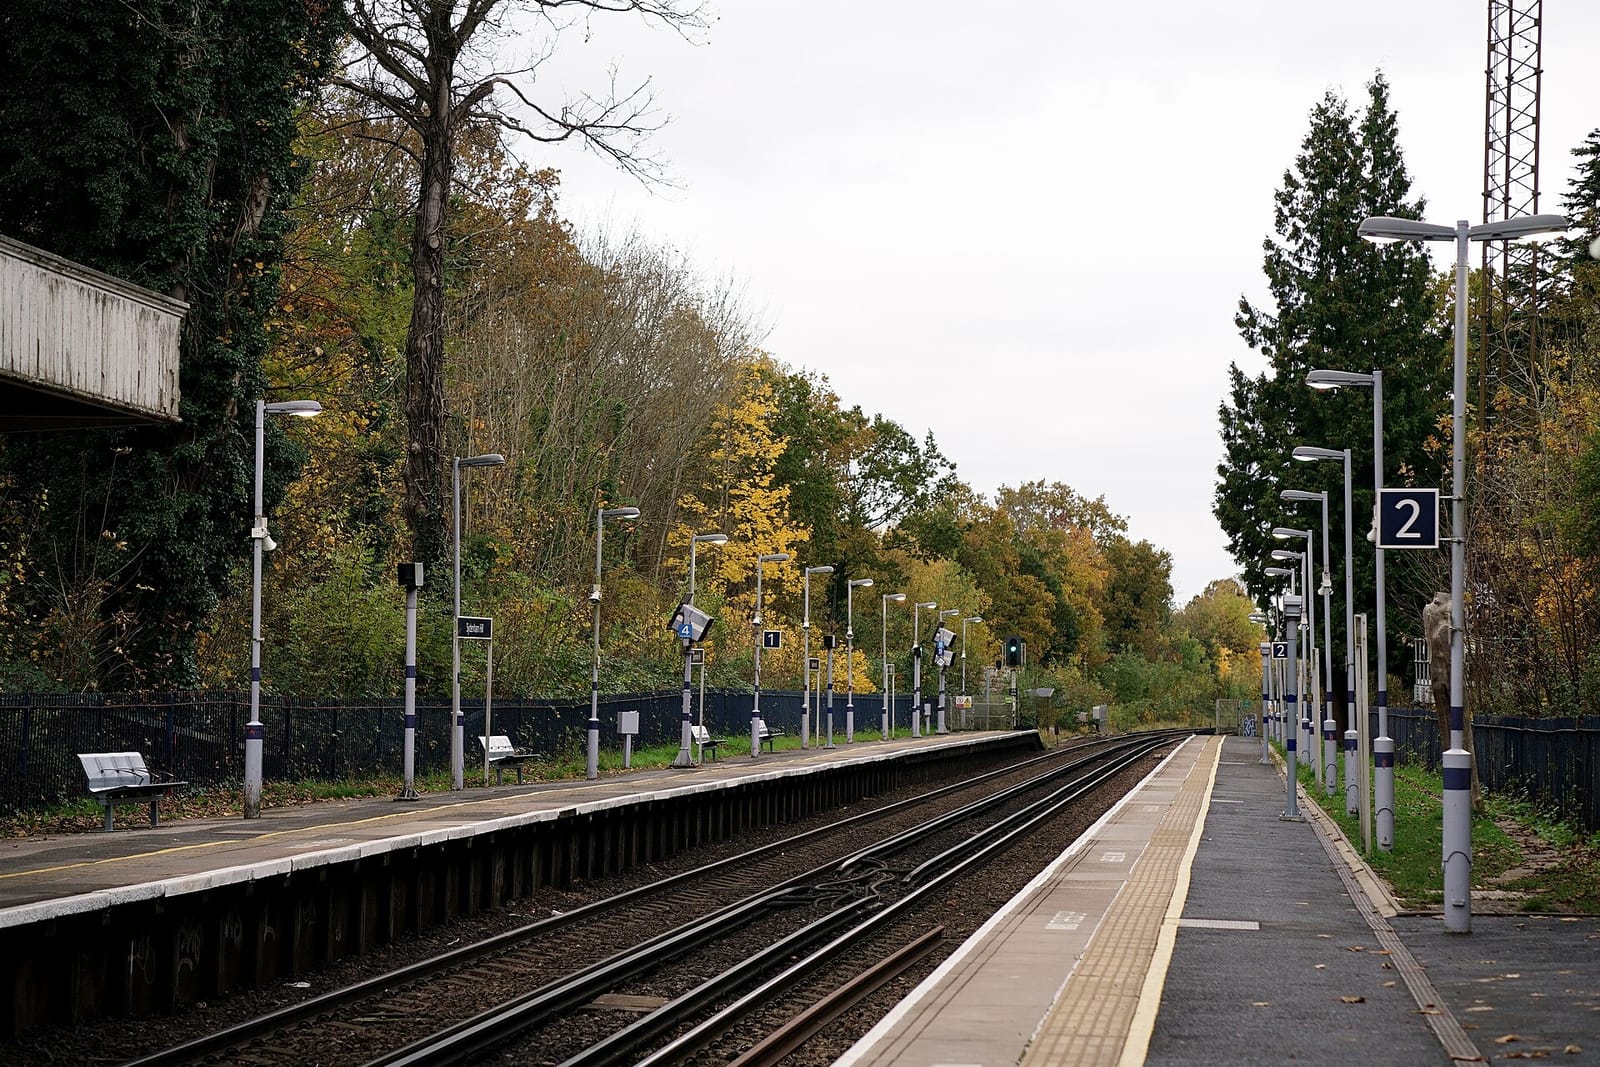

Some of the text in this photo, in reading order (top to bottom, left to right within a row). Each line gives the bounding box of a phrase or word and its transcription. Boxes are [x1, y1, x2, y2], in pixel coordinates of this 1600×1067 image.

[1394, 498, 1421, 538] 2
[681, 625, 690, 635] 4
[767, 633, 774, 646] 1
[1276, 644, 1285, 657] 2
